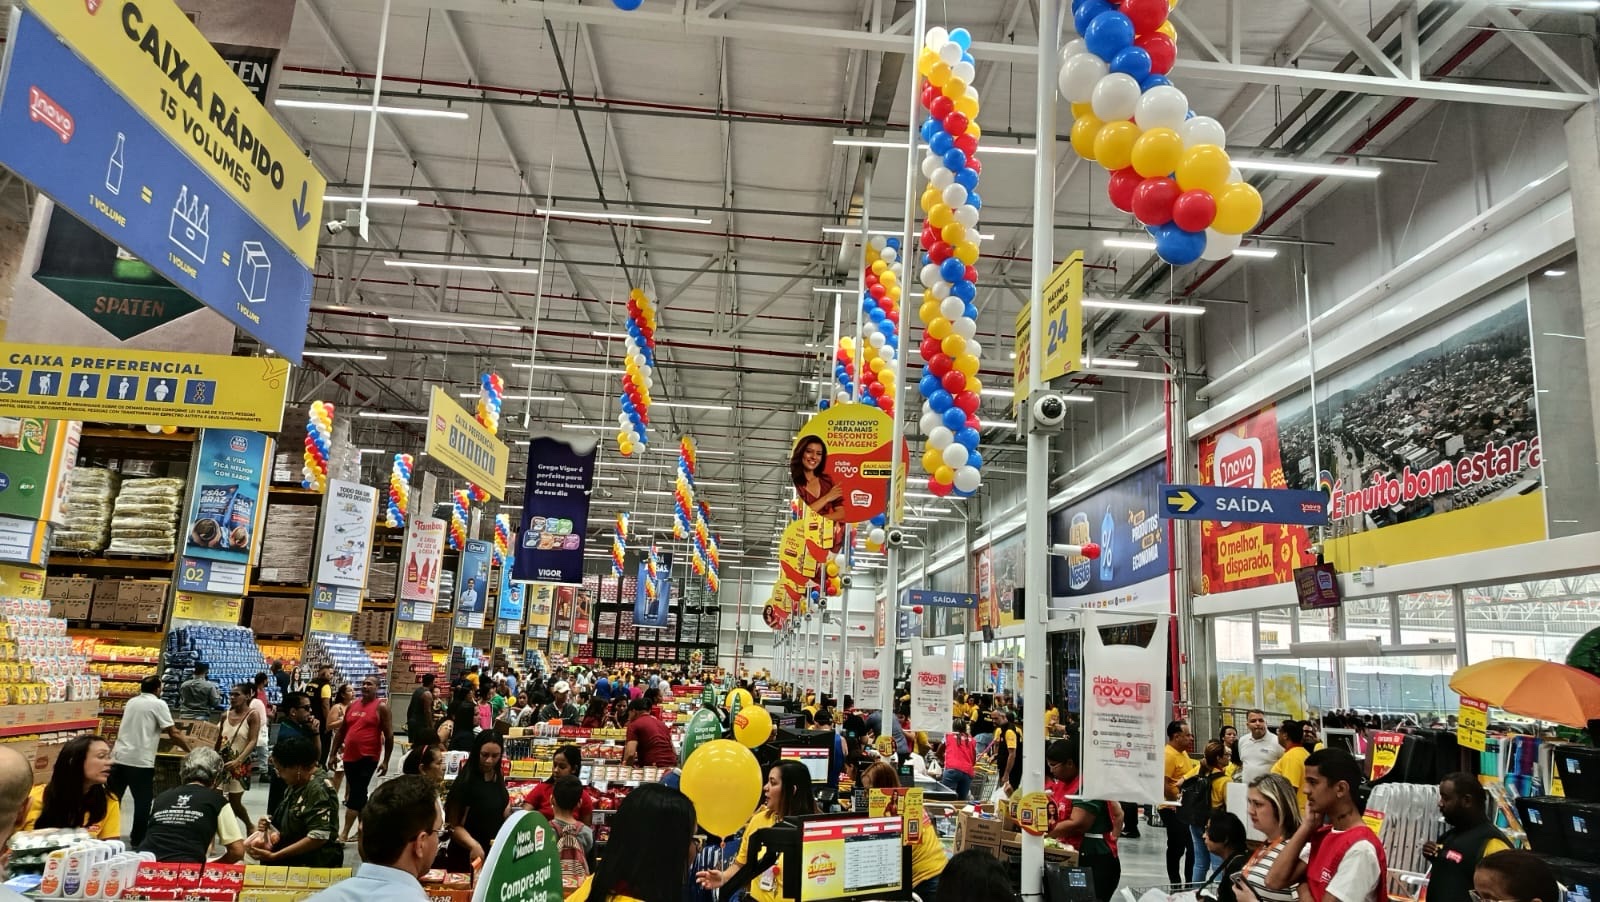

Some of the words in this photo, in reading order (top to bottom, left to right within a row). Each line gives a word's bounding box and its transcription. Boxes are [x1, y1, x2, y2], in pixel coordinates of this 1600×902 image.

[225, 60, 267, 84] TEN
[121, 2, 203, 110] CAIXA
[209, 92, 284, 190] RÁPIDO
[160, 88, 177, 120] 15
[182, 110, 251, 193] VOLUMES
[94, 197, 126, 227] VOLUME
[173, 255, 197, 278] VOLUME
[94, 296, 165, 317] SPATEN
[241, 304, 260, 324] VOLUME
[1048, 293, 1068, 316] VOLUMES
[1047, 308, 1068, 357] 24
[9, 353, 65, 367] CAIXA
[71, 357, 204, 375] PREFERENCIAL
[827, 432, 878, 440] DESCONTOS
[827, 440, 878, 448] VANTAGENS
[213, 462, 229, 470] FICA
[230, 464, 253, 475] MELHOR
[215, 470, 230, 478] COM
[231, 473, 251, 482] SABOR
[536, 472, 565, 481] perfeito
[559, 464, 578, 473] Vigor
[339, 486, 354, 494] TODO
[535, 480, 555, 488] todas
[564, 482, 585, 490] horas
[1332, 479, 1343, 520] É
[1345, 472, 1400, 518] muito
[1402, 466, 1454, 501] bom
[1457, 441, 1527, 485] estar
[201, 495, 227, 504] BRAZ
[337, 492, 353, 500] NOVO
[1215, 494, 1274, 513] SAÍDA
[1131, 513, 1158, 543] PRODUTOS
[1219, 541, 1227, 557] O
[1227, 533, 1261, 555] melhor,
[1132, 543, 1159, 571] ECONOMIA
[1225, 556, 1272, 577] disparado.
[185, 567, 204, 582] 02
[538, 568, 562, 577] VIGOR
[319, 591, 333, 602] 03
[932, 595, 957, 604] SAÍDA
[1093, 675, 1119, 685] clube
[1093, 684, 1133, 697] novo
[517, 830, 531, 845] Novo
[515, 840, 535, 859] Mundo
[501, 873, 534, 902] Compre
[535, 857, 551, 887] aqui
